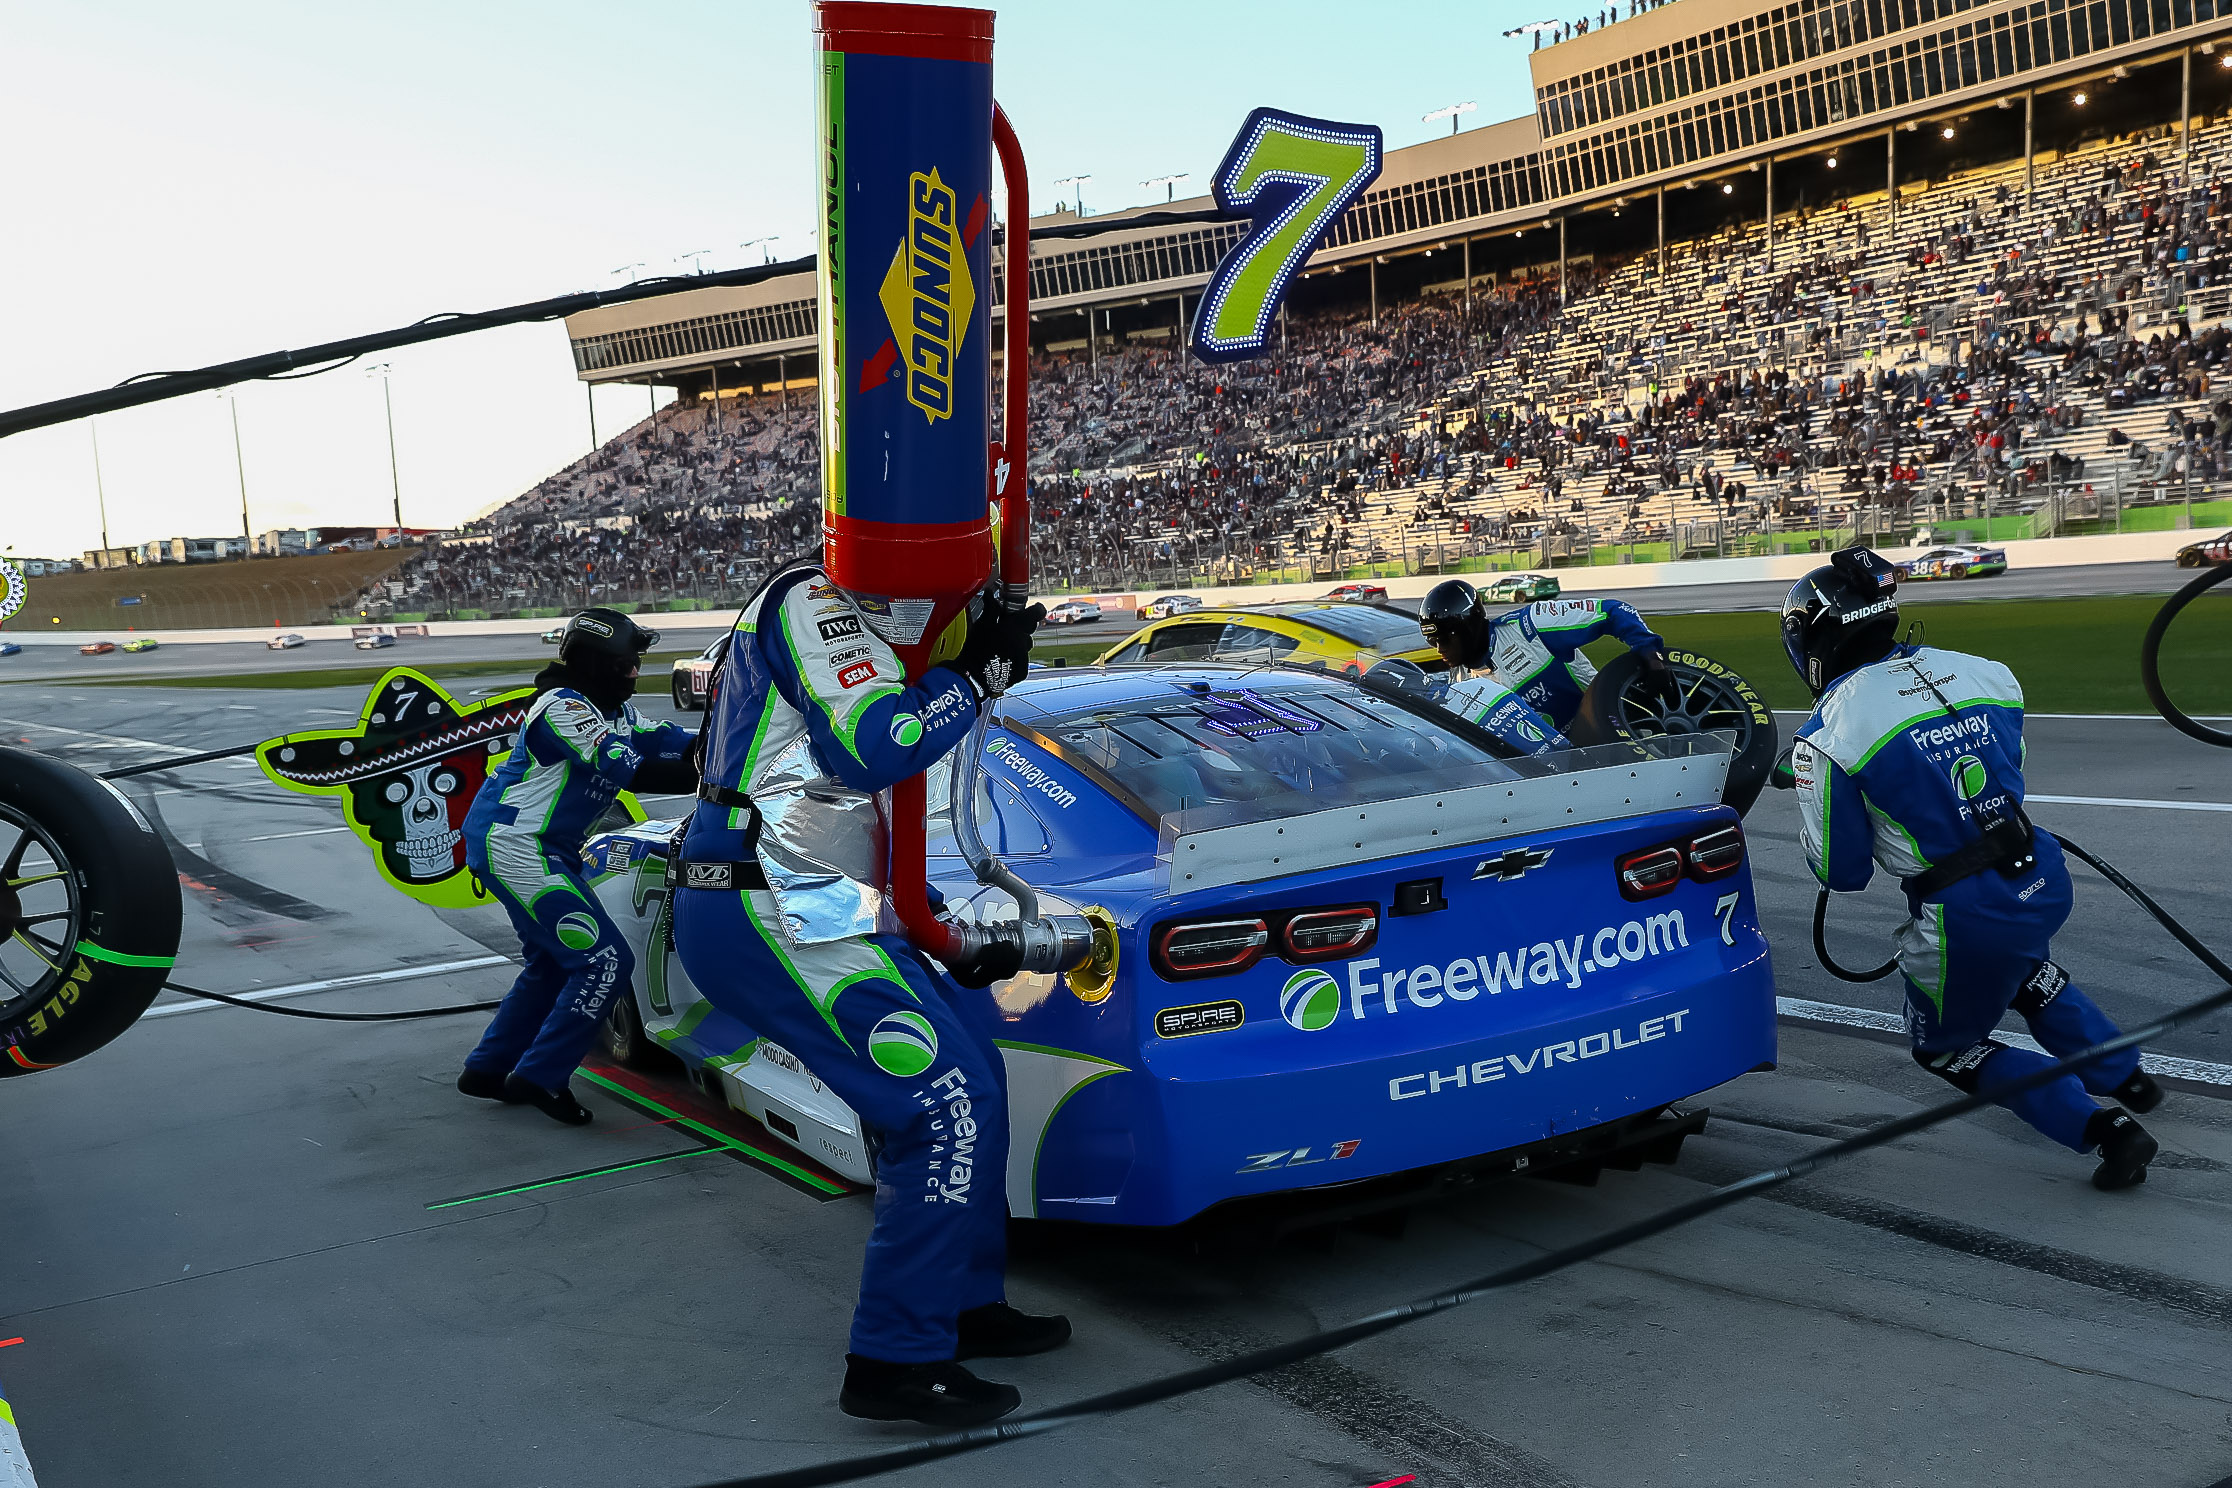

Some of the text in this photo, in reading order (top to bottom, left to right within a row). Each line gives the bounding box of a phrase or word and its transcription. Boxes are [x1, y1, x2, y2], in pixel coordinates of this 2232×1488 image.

[1202, 117, 1376, 350] 7
[911, 178, 951, 416] SUNOCO
[1854, 551, 1872, 568] 7
[1911, 561, 1928, 575] 38
[1485, 588, 1498, 599] 42
[822, 618, 858, 636] TWG
[831, 647, 870, 664] COMETIC
[844, 666, 872, 684] SEM
[1668, 651, 1769, 725] GOODYEAR
[395, 692, 418, 721] 7
[995, 742, 1077, 809] Freeway.com
[2018, 878, 2046, 901] sparco
[1714, 891, 1739, 946] 7
[1348, 909, 1690, 1020] Freeway.com
[28, 940, 101, 1036] AGLE
[779, 1051, 799, 1073] CASINO
[1389, 1009, 1690, 1101] CHEVROLET
[931, 1067, 977, 1204] Freeway
[1235, 1139, 1362, 1174] ZL1
